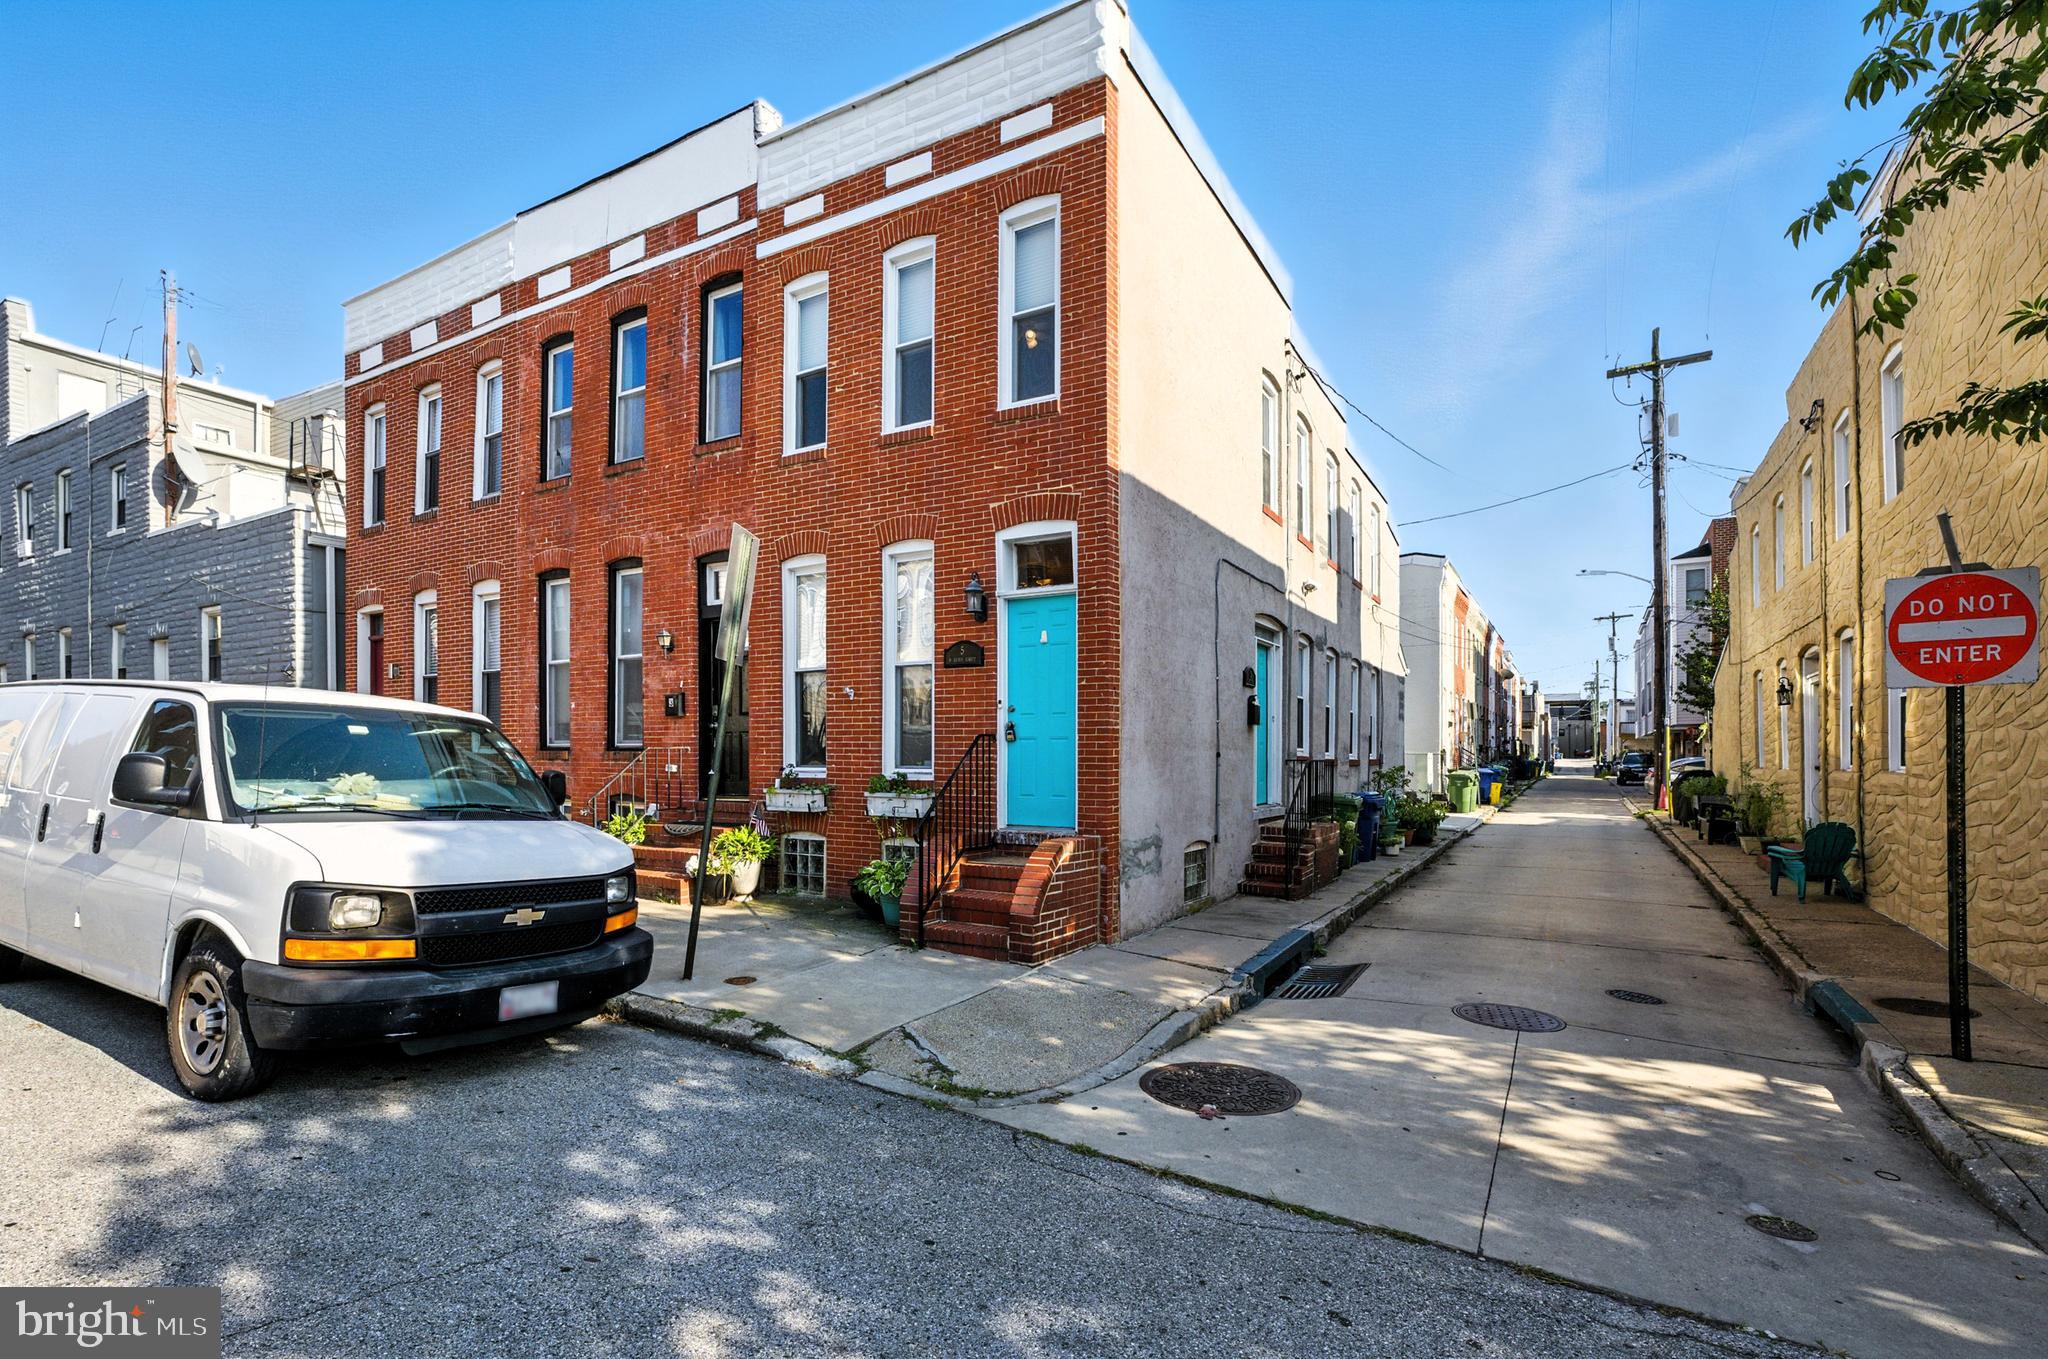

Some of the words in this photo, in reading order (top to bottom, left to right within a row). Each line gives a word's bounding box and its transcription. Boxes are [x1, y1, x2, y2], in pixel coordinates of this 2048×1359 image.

[1910, 598, 1944, 617] DO
[1958, 593, 2013, 613] NOT
[1920, 644, 2001, 665] ENTER
